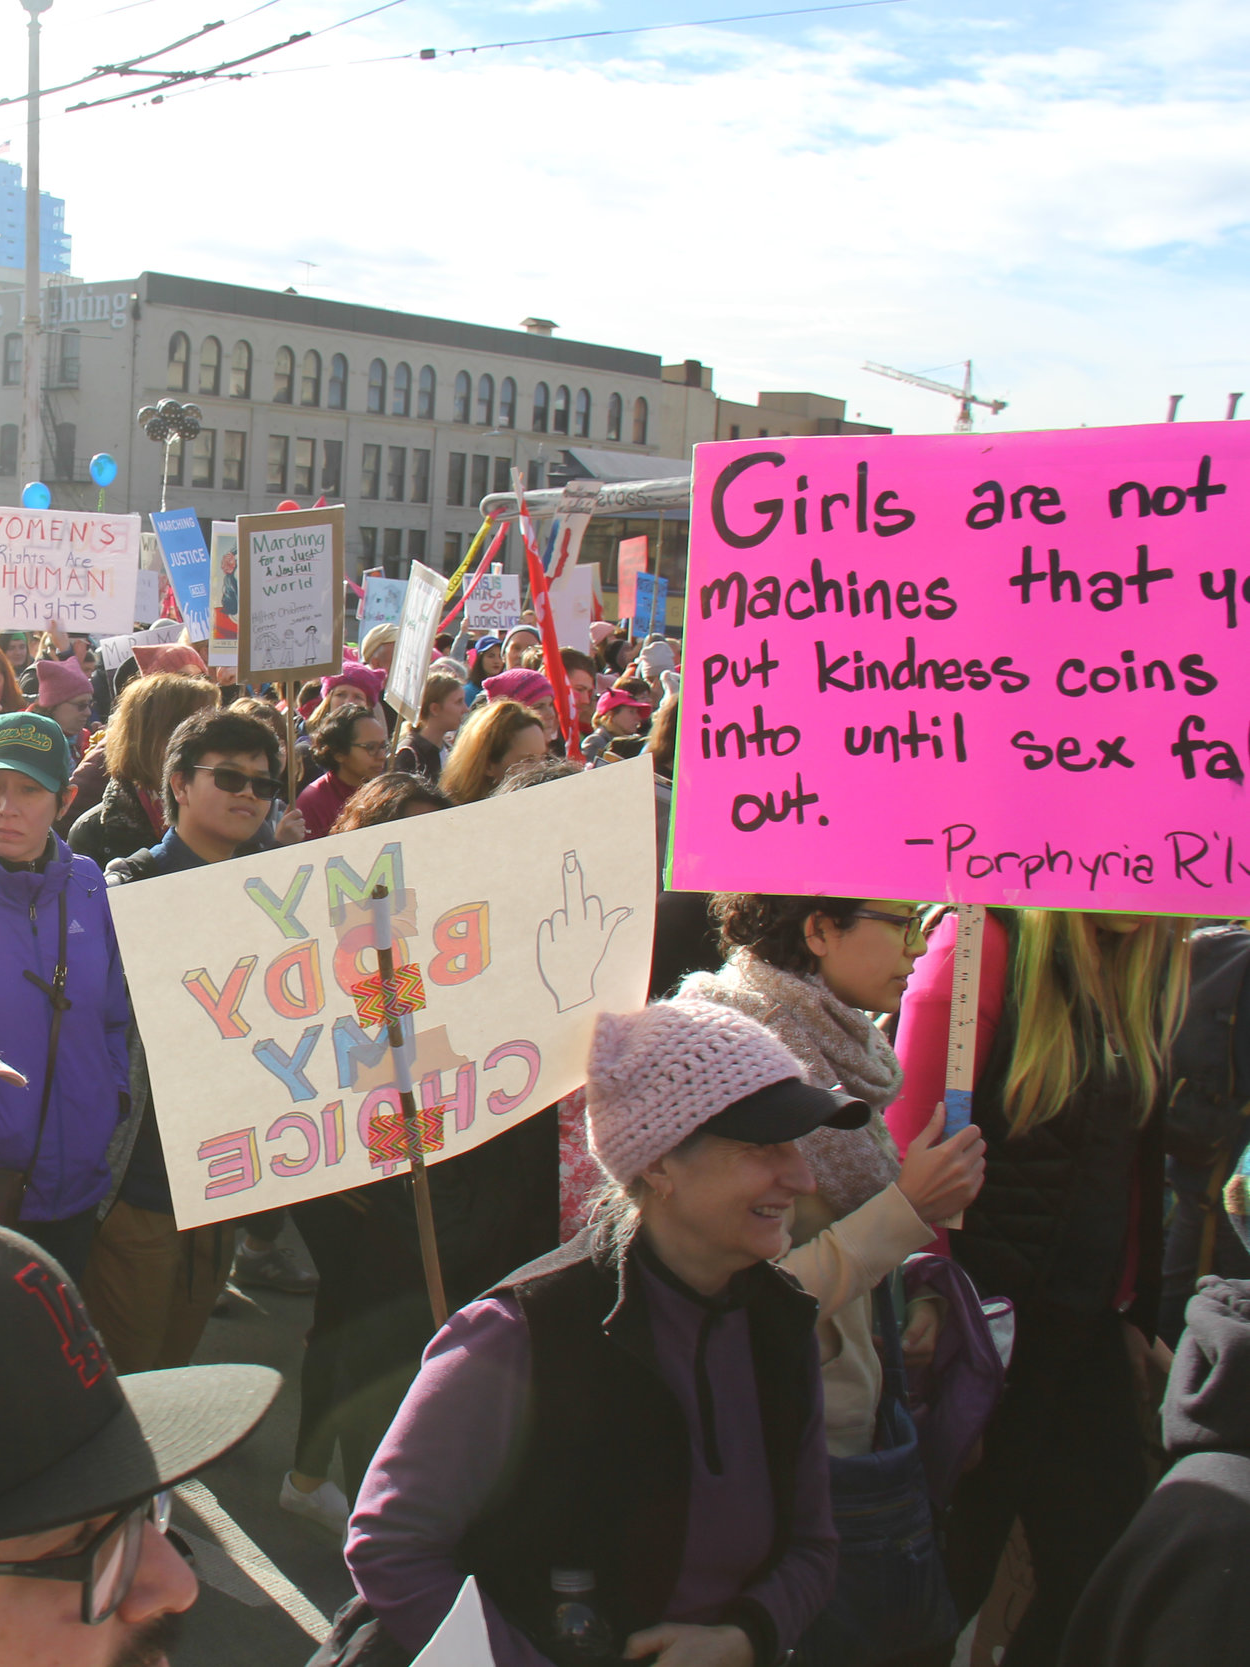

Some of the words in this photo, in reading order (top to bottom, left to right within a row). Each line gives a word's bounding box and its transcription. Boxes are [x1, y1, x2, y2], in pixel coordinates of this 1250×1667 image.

[711, 451, 916, 549] Girls
[965, 480, 1067, 530] are
[1108, 455, 1227, 519] not
[157, 517, 196, 532] MARCHING
[253, 532, 326, 555] Marching
[65, 551, 95, 569] Are
[170, 548, 207, 567] JUSTICE
[259, 556, 274, 567] for
[276, 562, 311, 577] Joyful
[2, 564, 105, 592] HUMAN
[700, 558, 958, 627] machines
[1009, 545, 1173, 611] that
[12, 594, 97, 620] Rights
[480, 592, 517, 614] Love
[702, 638, 779, 705] put
[814, 637, 1030, 693] kindness
[1056, 650, 1218, 697] coins
[701, 705, 801, 759] into
[844, 710, 968, 763] until
[1011, 730, 1135, 771] sex
[731, 772, 830, 831] out.
